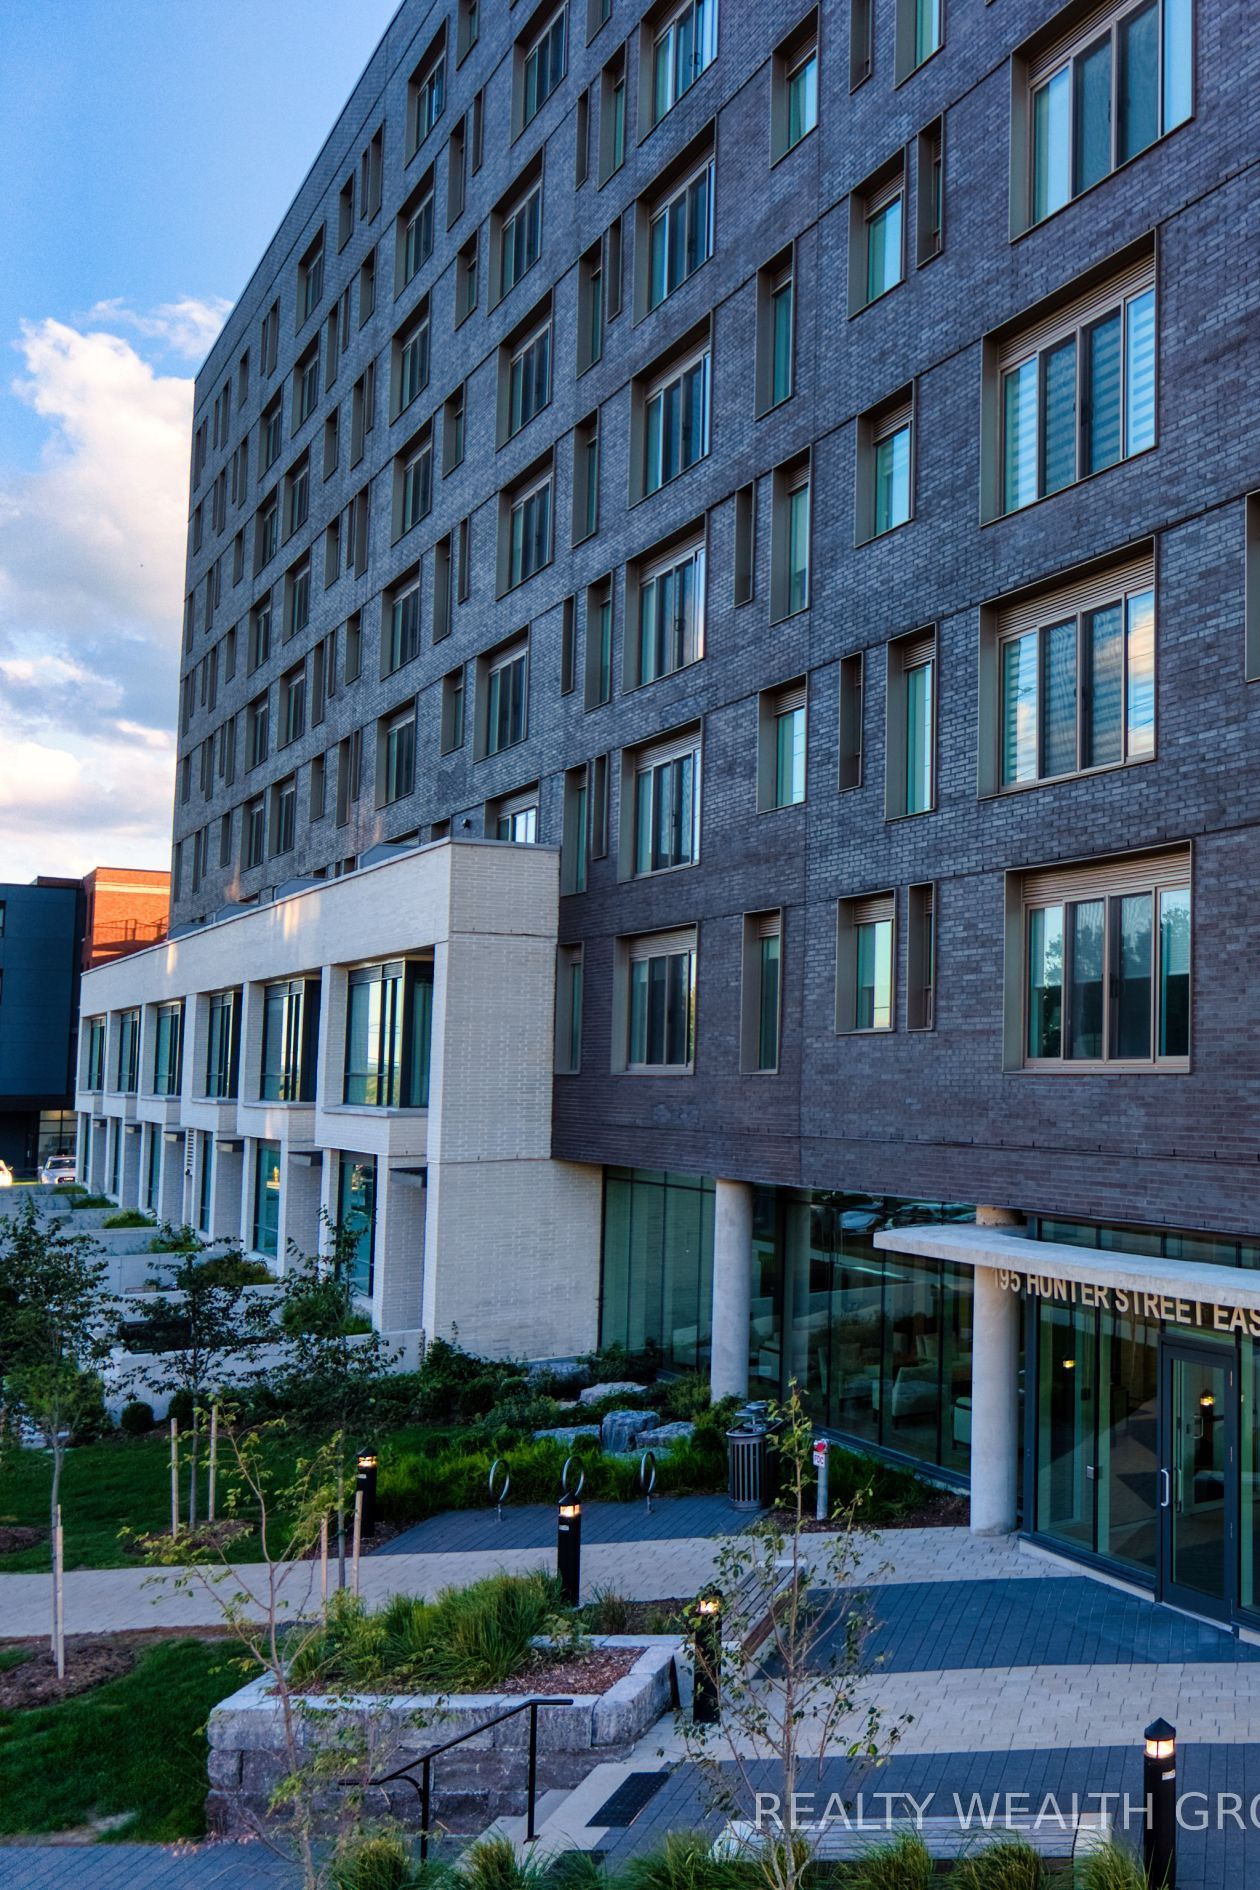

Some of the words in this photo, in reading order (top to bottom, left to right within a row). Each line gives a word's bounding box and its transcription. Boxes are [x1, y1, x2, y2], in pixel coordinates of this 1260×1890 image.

[993, 1268, 1021, 1292] 195
[1027, 1273, 1110, 1309] HUNTER
[1115, 1288, 1202, 1326] STREET
